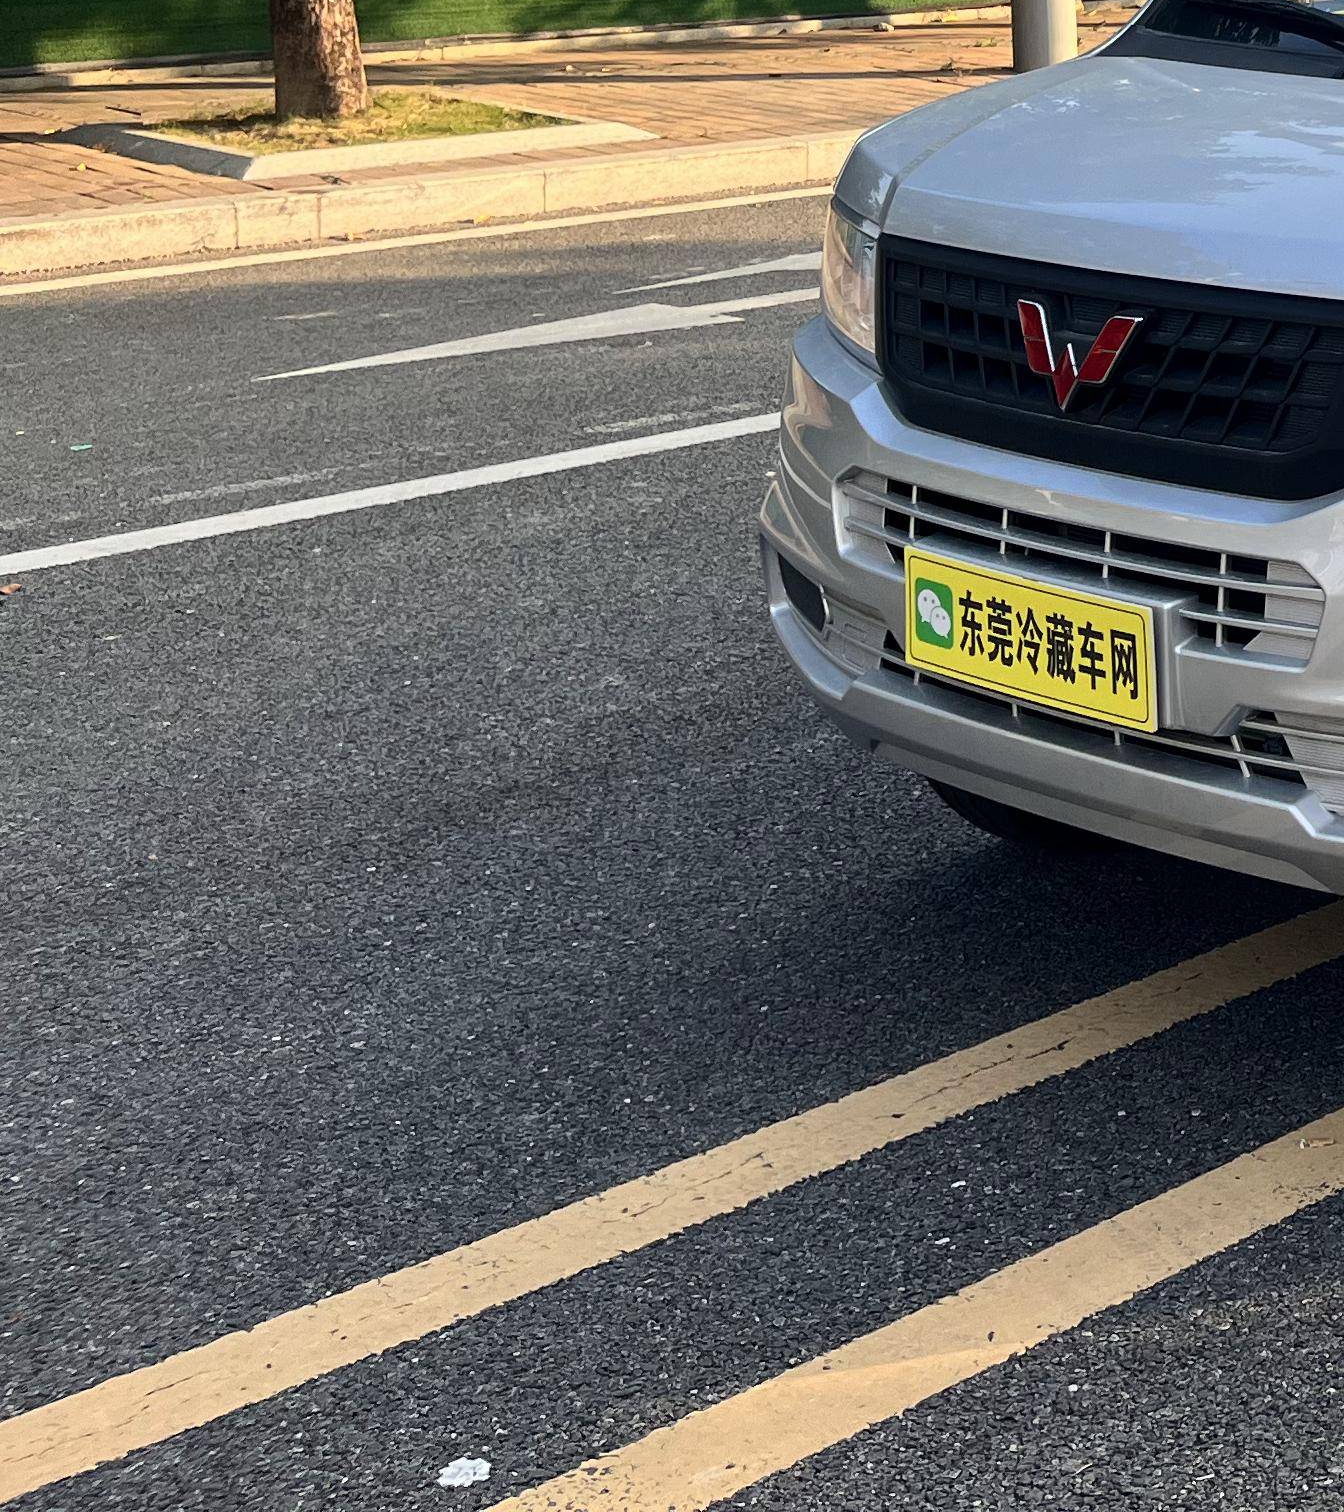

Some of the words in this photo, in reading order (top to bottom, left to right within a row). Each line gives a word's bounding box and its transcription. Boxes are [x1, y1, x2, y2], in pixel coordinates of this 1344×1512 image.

[958, 590, 1139, 700] 东莞冷藏车网
